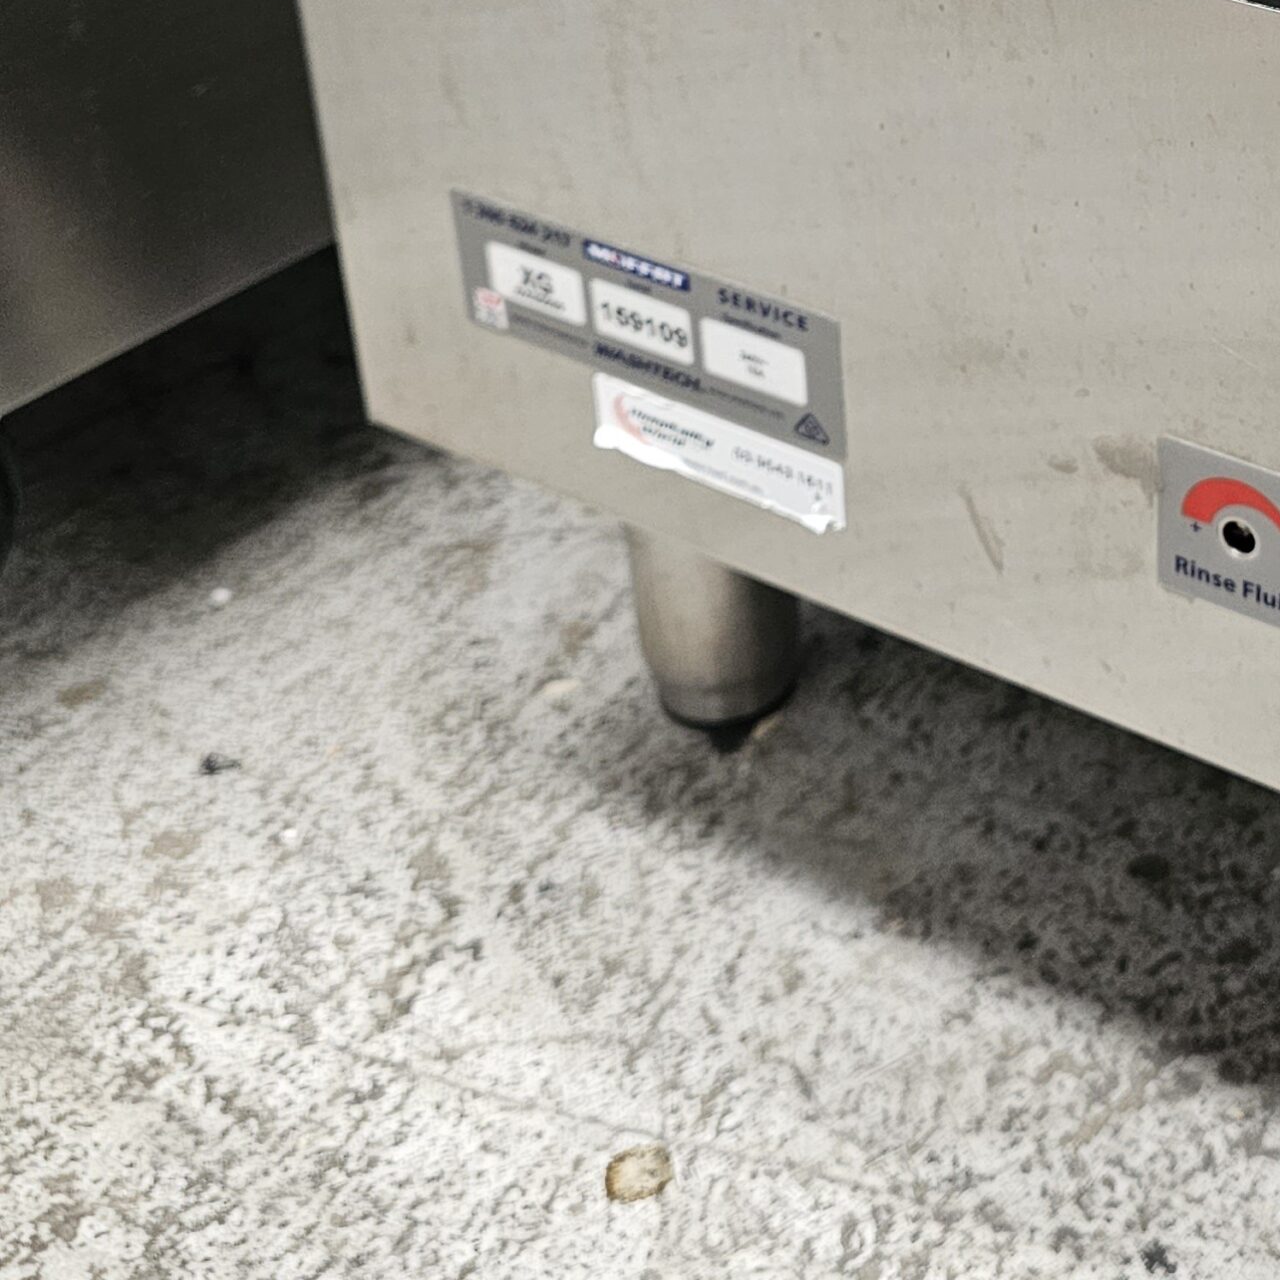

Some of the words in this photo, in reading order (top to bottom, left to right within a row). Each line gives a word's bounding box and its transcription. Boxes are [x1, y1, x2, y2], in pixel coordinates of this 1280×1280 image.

[600, 301, 689, 348] 159109
[717, 287, 810, 332] SERVICE
[594, 342, 702, 391] WASHTECH
[1174, 553, 1237, 594] Rinse
